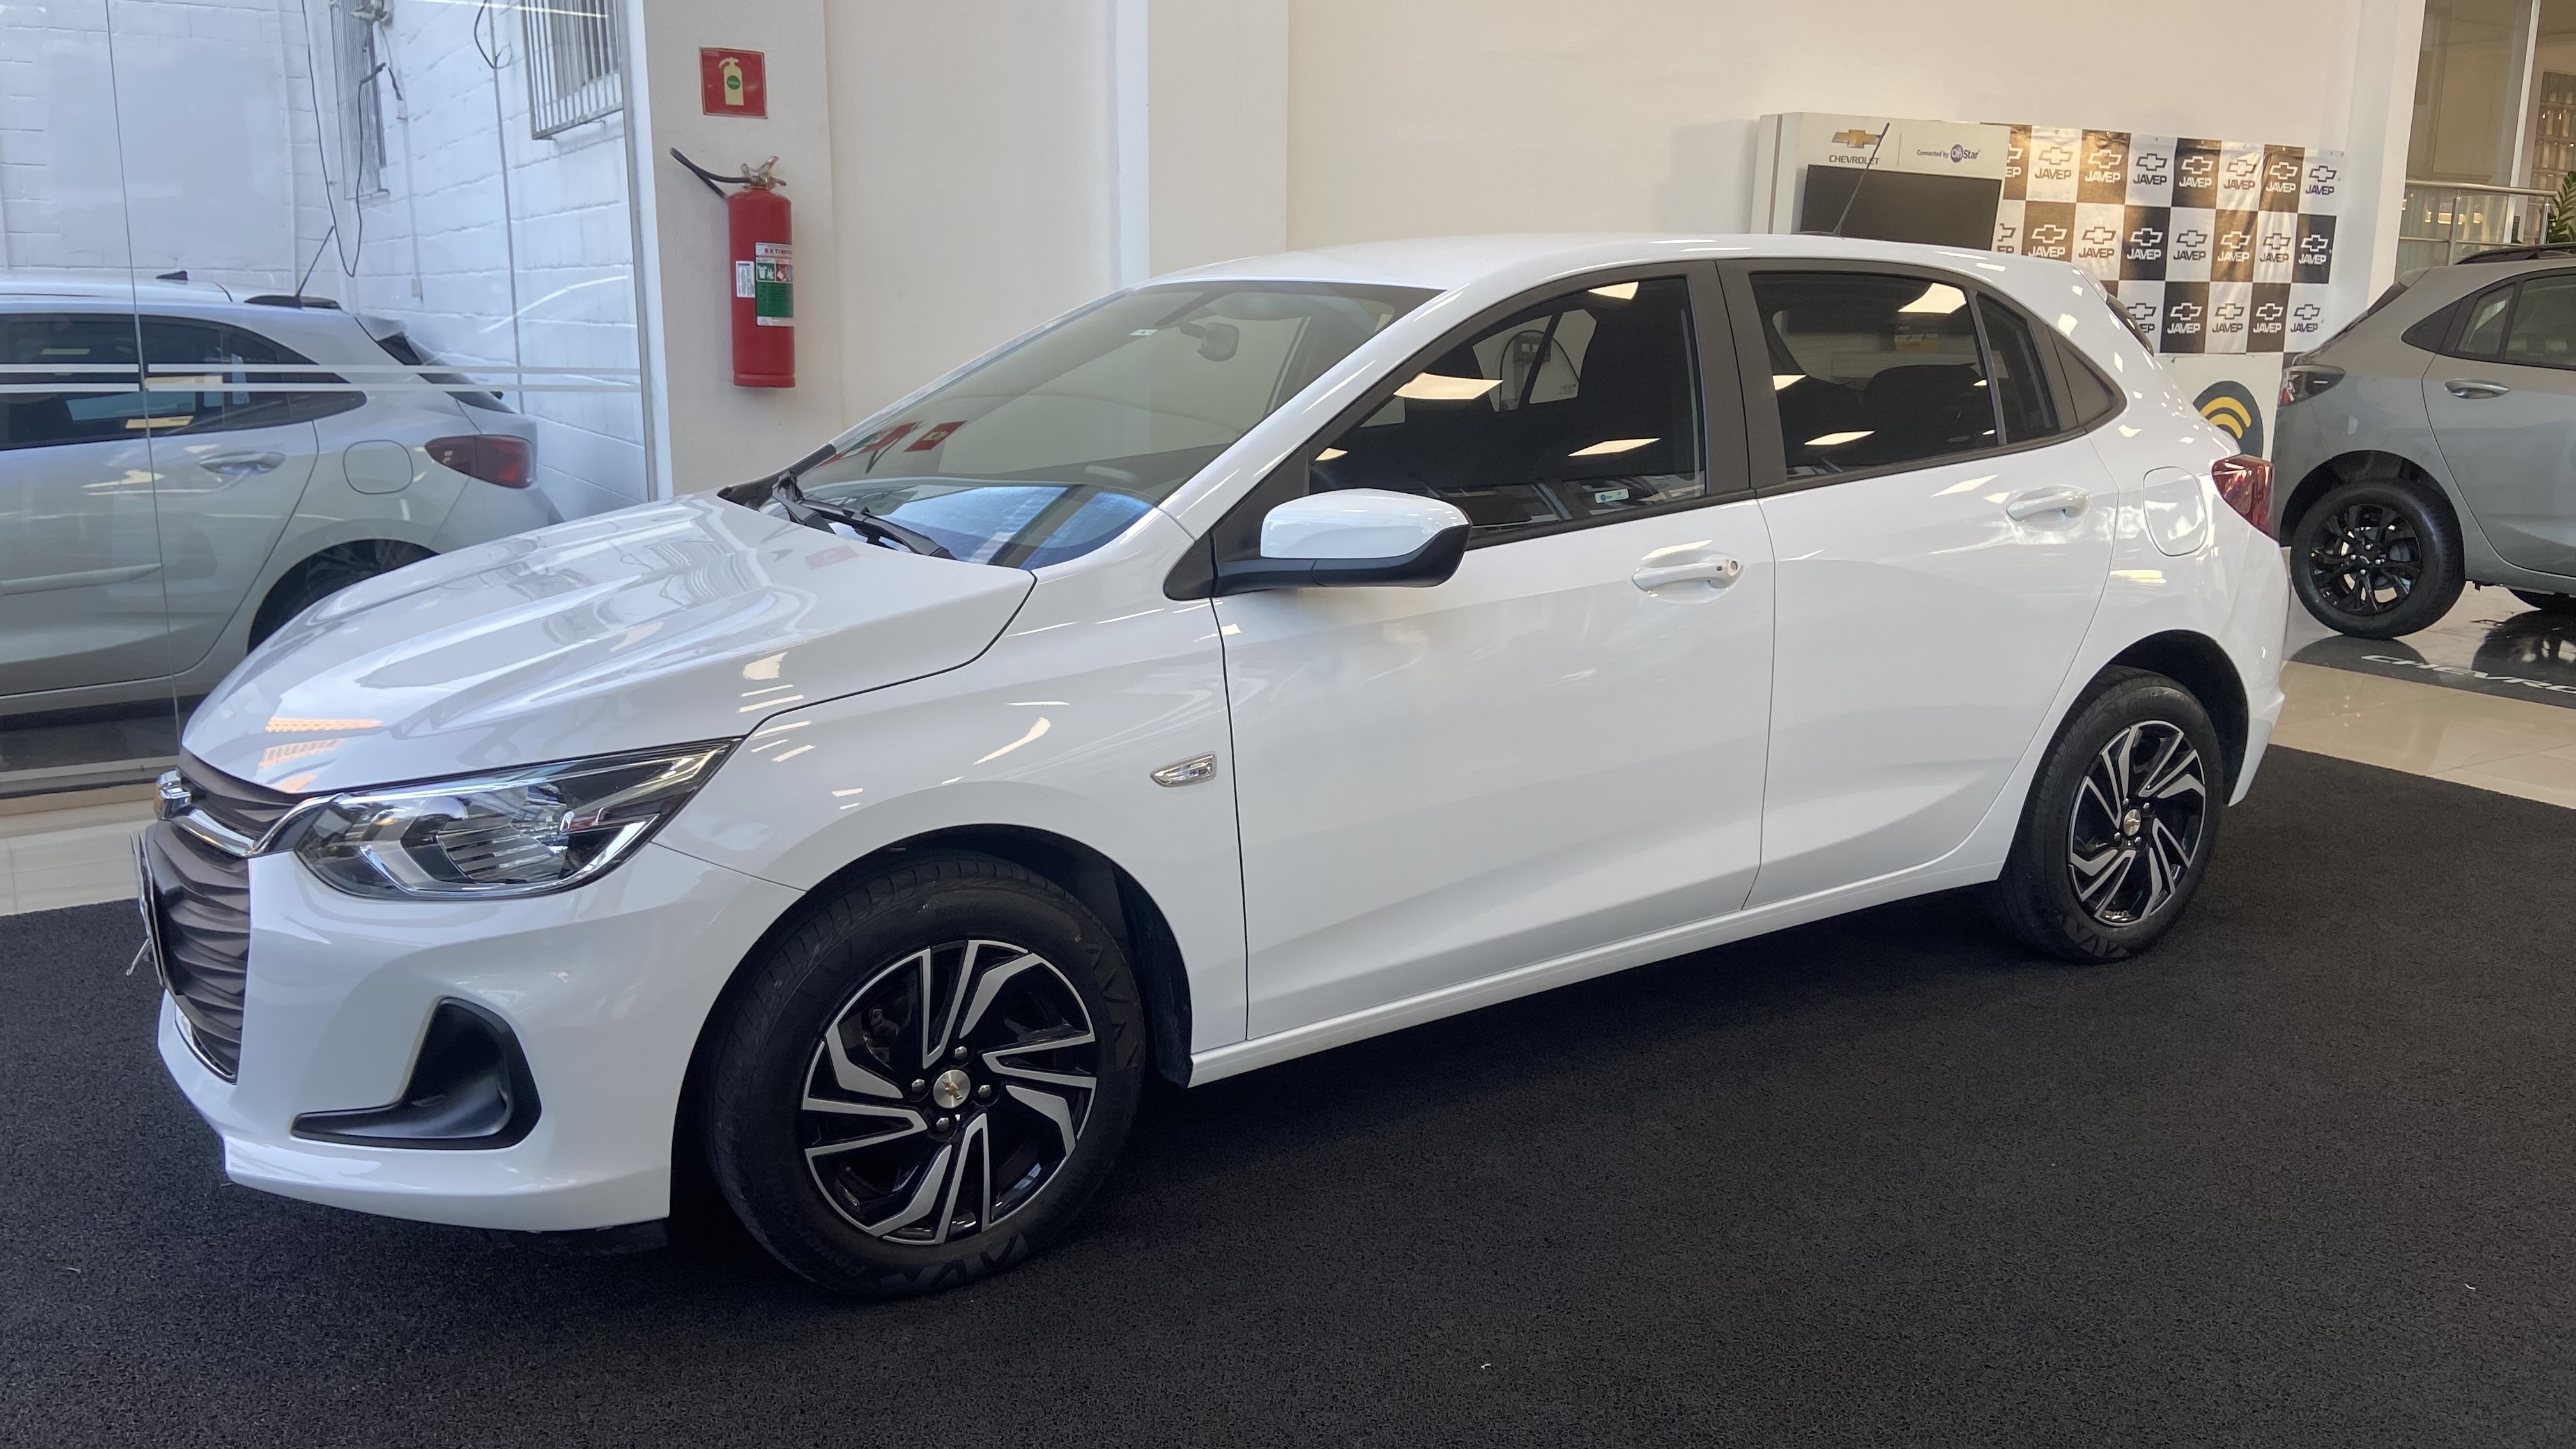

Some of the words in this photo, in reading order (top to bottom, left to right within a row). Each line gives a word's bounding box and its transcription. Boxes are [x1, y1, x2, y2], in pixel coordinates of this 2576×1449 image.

[1917, 149, 1942, 157] Connected
[1951, 146, 1979, 160] OnStar
[2035, 168, 2071, 180] JAVEP
[2085, 171, 2120, 183] JAVEP
[2133, 174, 2167, 185] JAVEP
[2179, 176, 2212, 188] JAVEP
[2223, 179, 2255, 190] JAVEP
[2266, 181, 2296, 193] JAVEP
[2305, 184, 2335, 195] JAVEP
[2028, 245, 2066, 257] JAVEP
[2078, 247, 2115, 258] JAVEP
[2126, 249, 2161, 260] JAVEP
[2173, 250, 2206, 261] JAVEP
[2218, 251, 2250, 263] JAVEP
[2260, 252, 2289, 263] JAVEP
[2298, 254, 2327, 264] JAVEP
[2166, 323, 2201, 334] JAVEP
[2212, 323, 2243, 333] JAVEP
[2253, 323, 2282, 334] JAVEP
[2290, 323, 2319, 333] JAVEP
